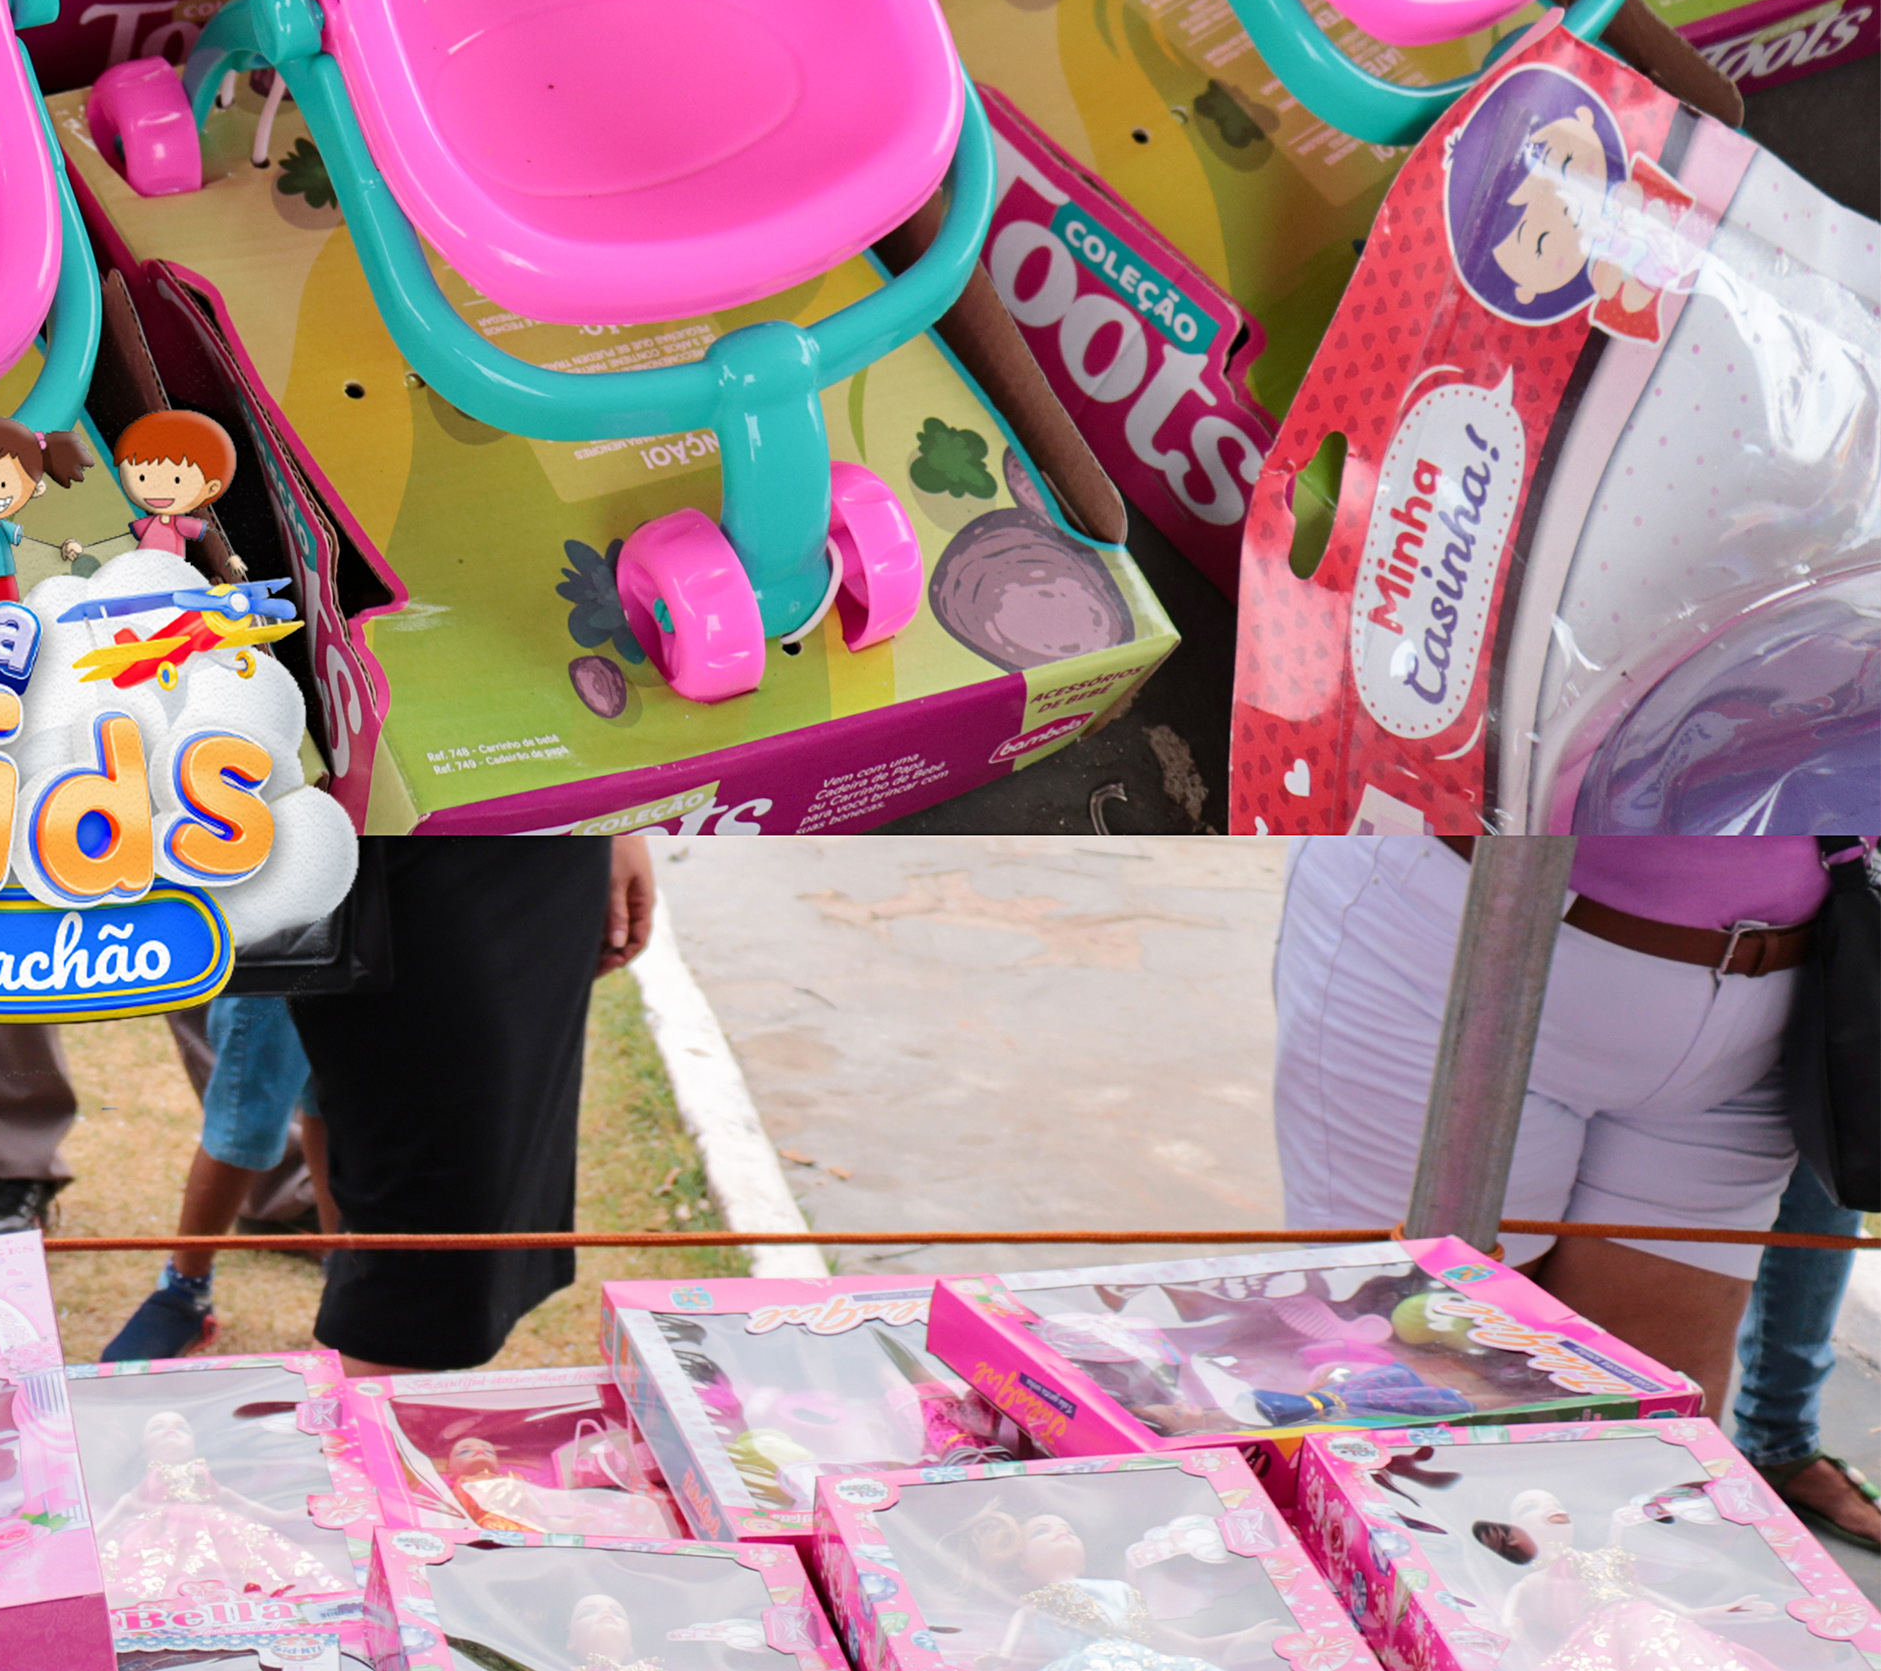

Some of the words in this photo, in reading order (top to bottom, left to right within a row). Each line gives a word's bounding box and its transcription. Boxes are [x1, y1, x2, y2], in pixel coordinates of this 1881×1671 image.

[1064, 219, 1199, 343] COLEÇÃO
[1367, 458, 1443, 636] Minha
[1402, 423, 1500, 705] Casinha!
[1029, 664, 1146, 705] ACESSÓRIOS
[1037, 697, 1065, 714] DE
[426, 750, 449, 763] Ref.
[448, 746, 471, 759] 748
[478, 739, 521, 754] Carrinho
[522, 737, 535, 747] de
[999, 719, 1082, 757] bambola
[433, 763, 455, 775] Ref.
[455, 758, 478, 771] 749
[530, 748, 544, 759] de
[823, 772, 854, 789] Vem
[856, 763, 887, 778] com
[889, 753, 920, 769] uma
[799, 808, 833, 828] para
[836, 795, 869, 814] você
[870, 779, 919, 803] brincar
[920, 770, 950, 786] com
[807, 801, 827, 813] ou
[830, 781, 890, 806] Carrinho
[892, 774, 910, 786] de
[815, 778, 869, 801] Cadeira
[871, 771, 889, 784] de
[582, 790, 706, 835] COLEÇÃO
[795, 820, 827, 836] suas
[118, 1601, 299, 1634] Bella
